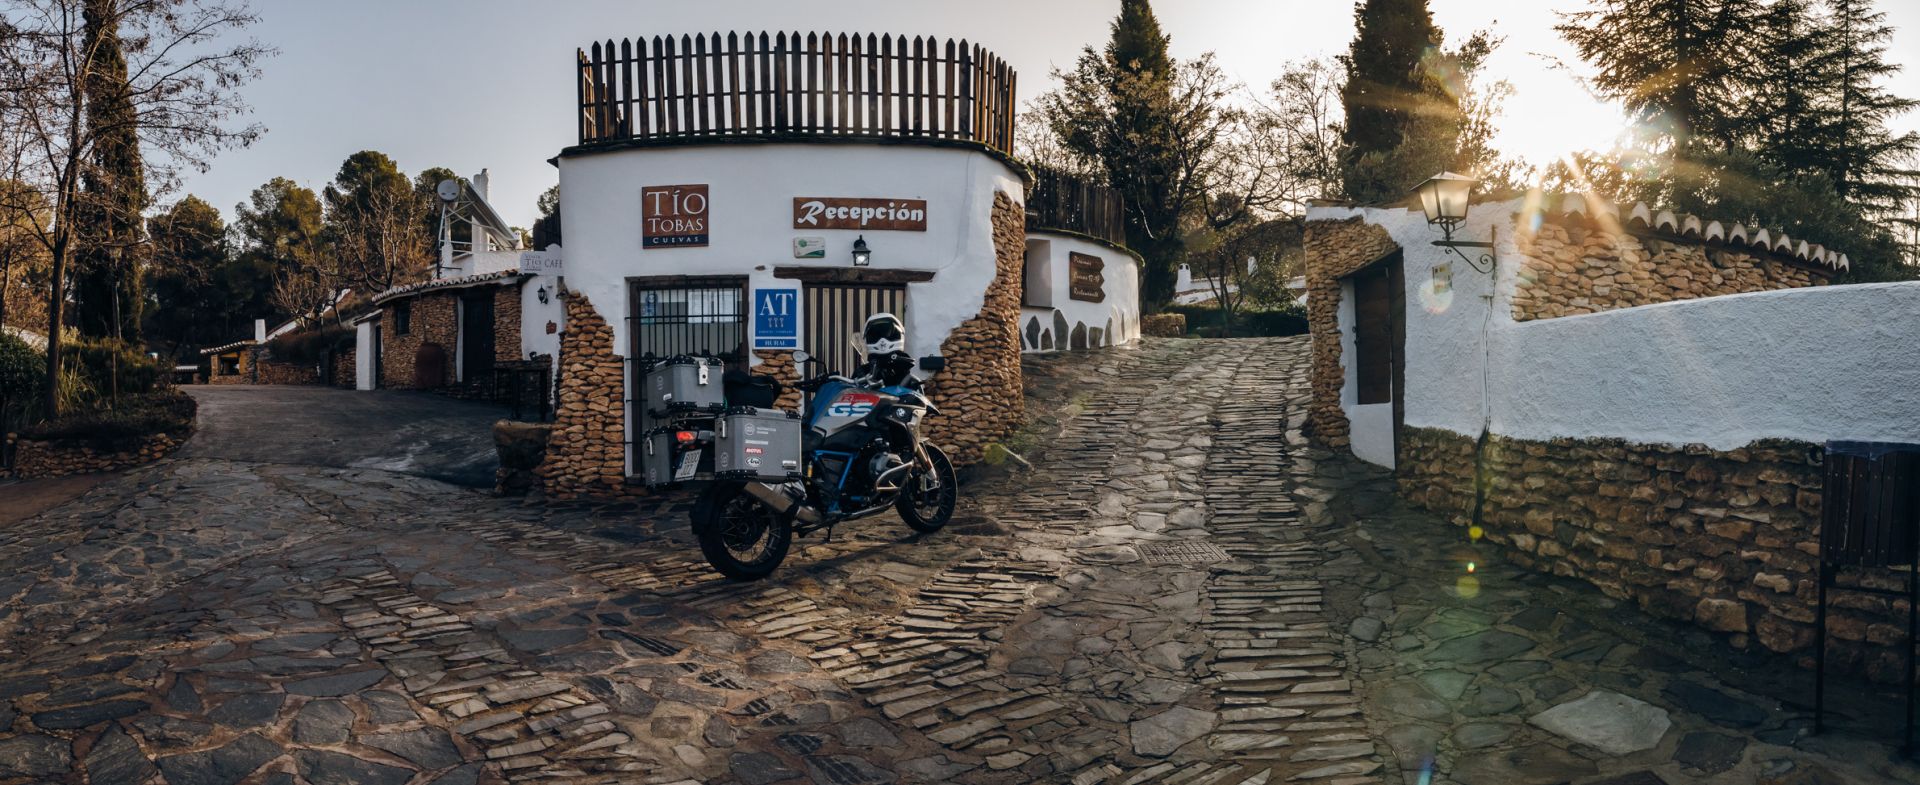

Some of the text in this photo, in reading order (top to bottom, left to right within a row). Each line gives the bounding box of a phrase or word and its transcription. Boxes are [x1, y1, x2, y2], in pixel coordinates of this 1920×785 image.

[646, 190, 706, 216] TÍO
[797, 201, 924, 226] Recepción
[648, 217, 704, 233] TOBAS
[652, 236, 699, 244] CUEVAS
[760, 293, 793, 316] AT
[828, 402, 874, 417] GS
